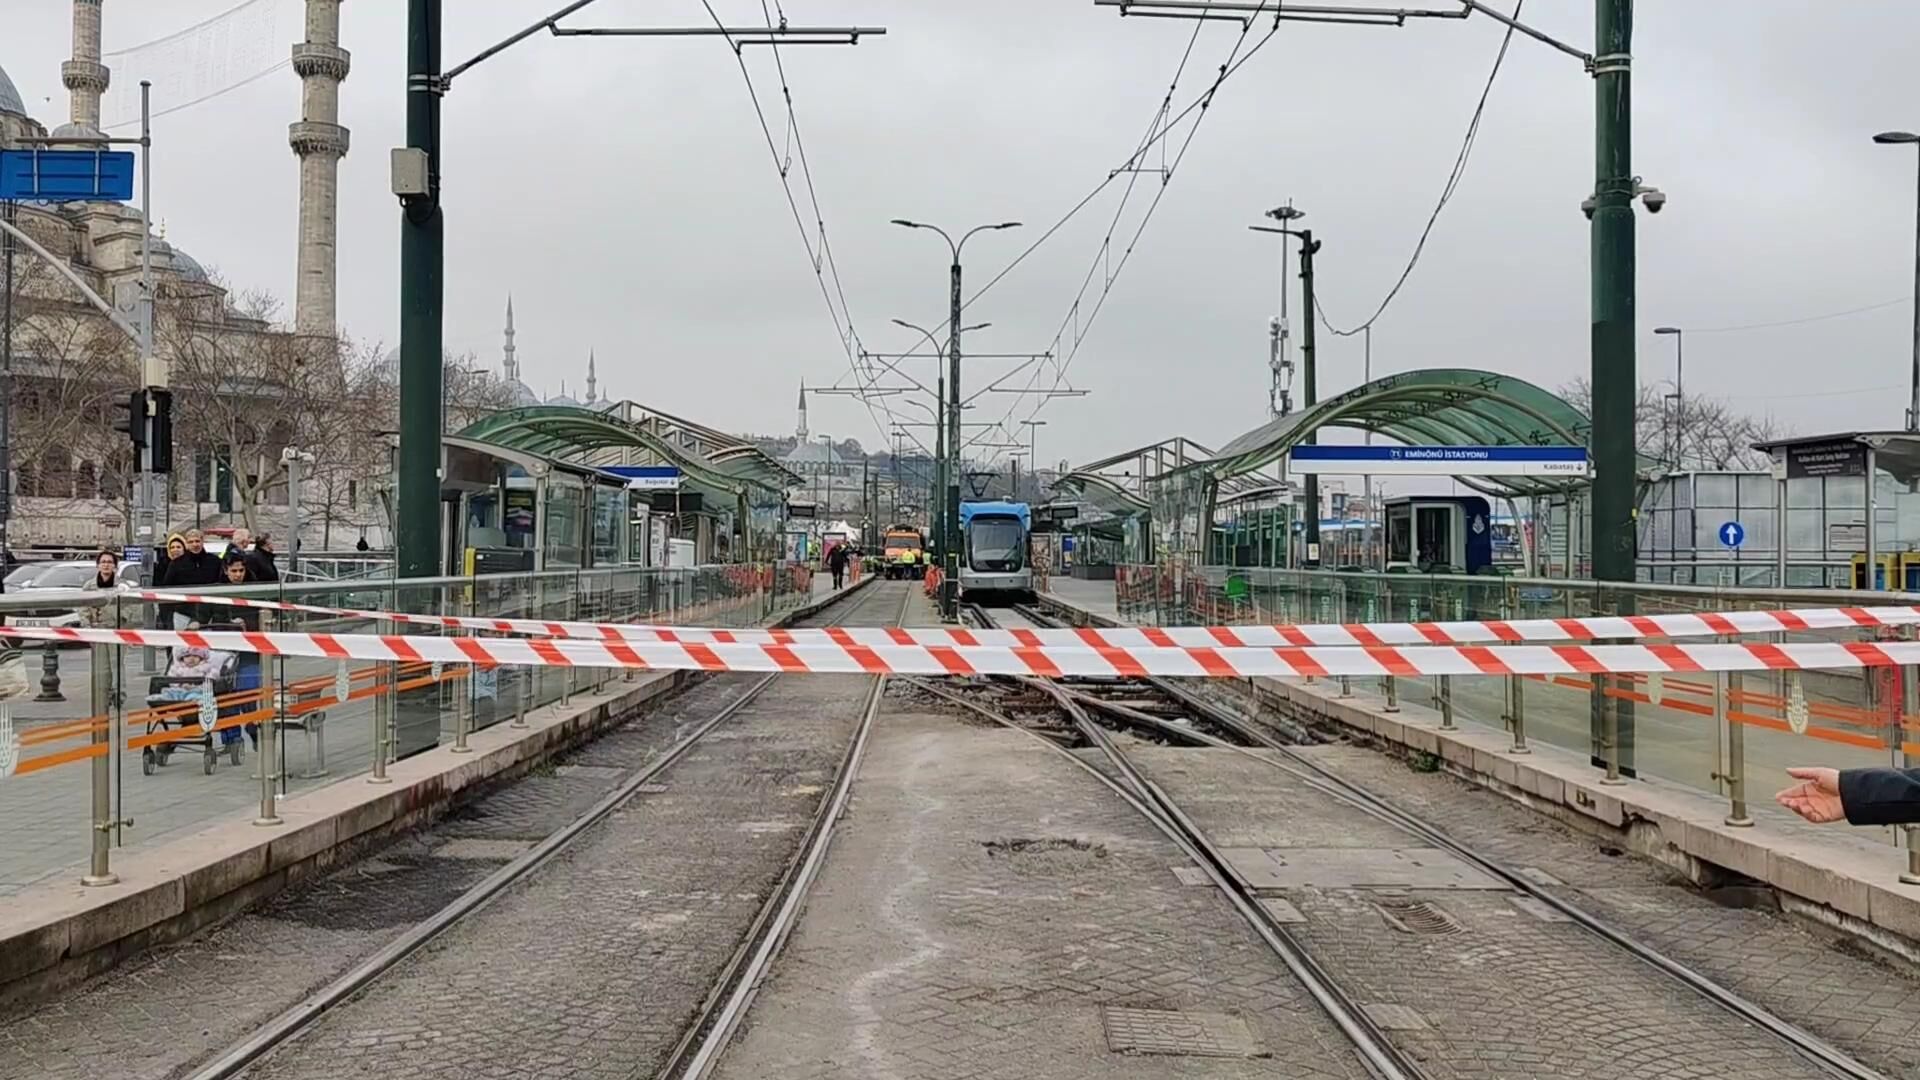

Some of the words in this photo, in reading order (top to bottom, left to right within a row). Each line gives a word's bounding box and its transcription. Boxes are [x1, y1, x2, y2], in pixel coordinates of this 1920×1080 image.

[1405, 449, 1443, 458] EMİNÖNÜ
[1444, 449, 1488, 459] İSTASYONU
[1543, 463, 1574, 471] Kabataş
